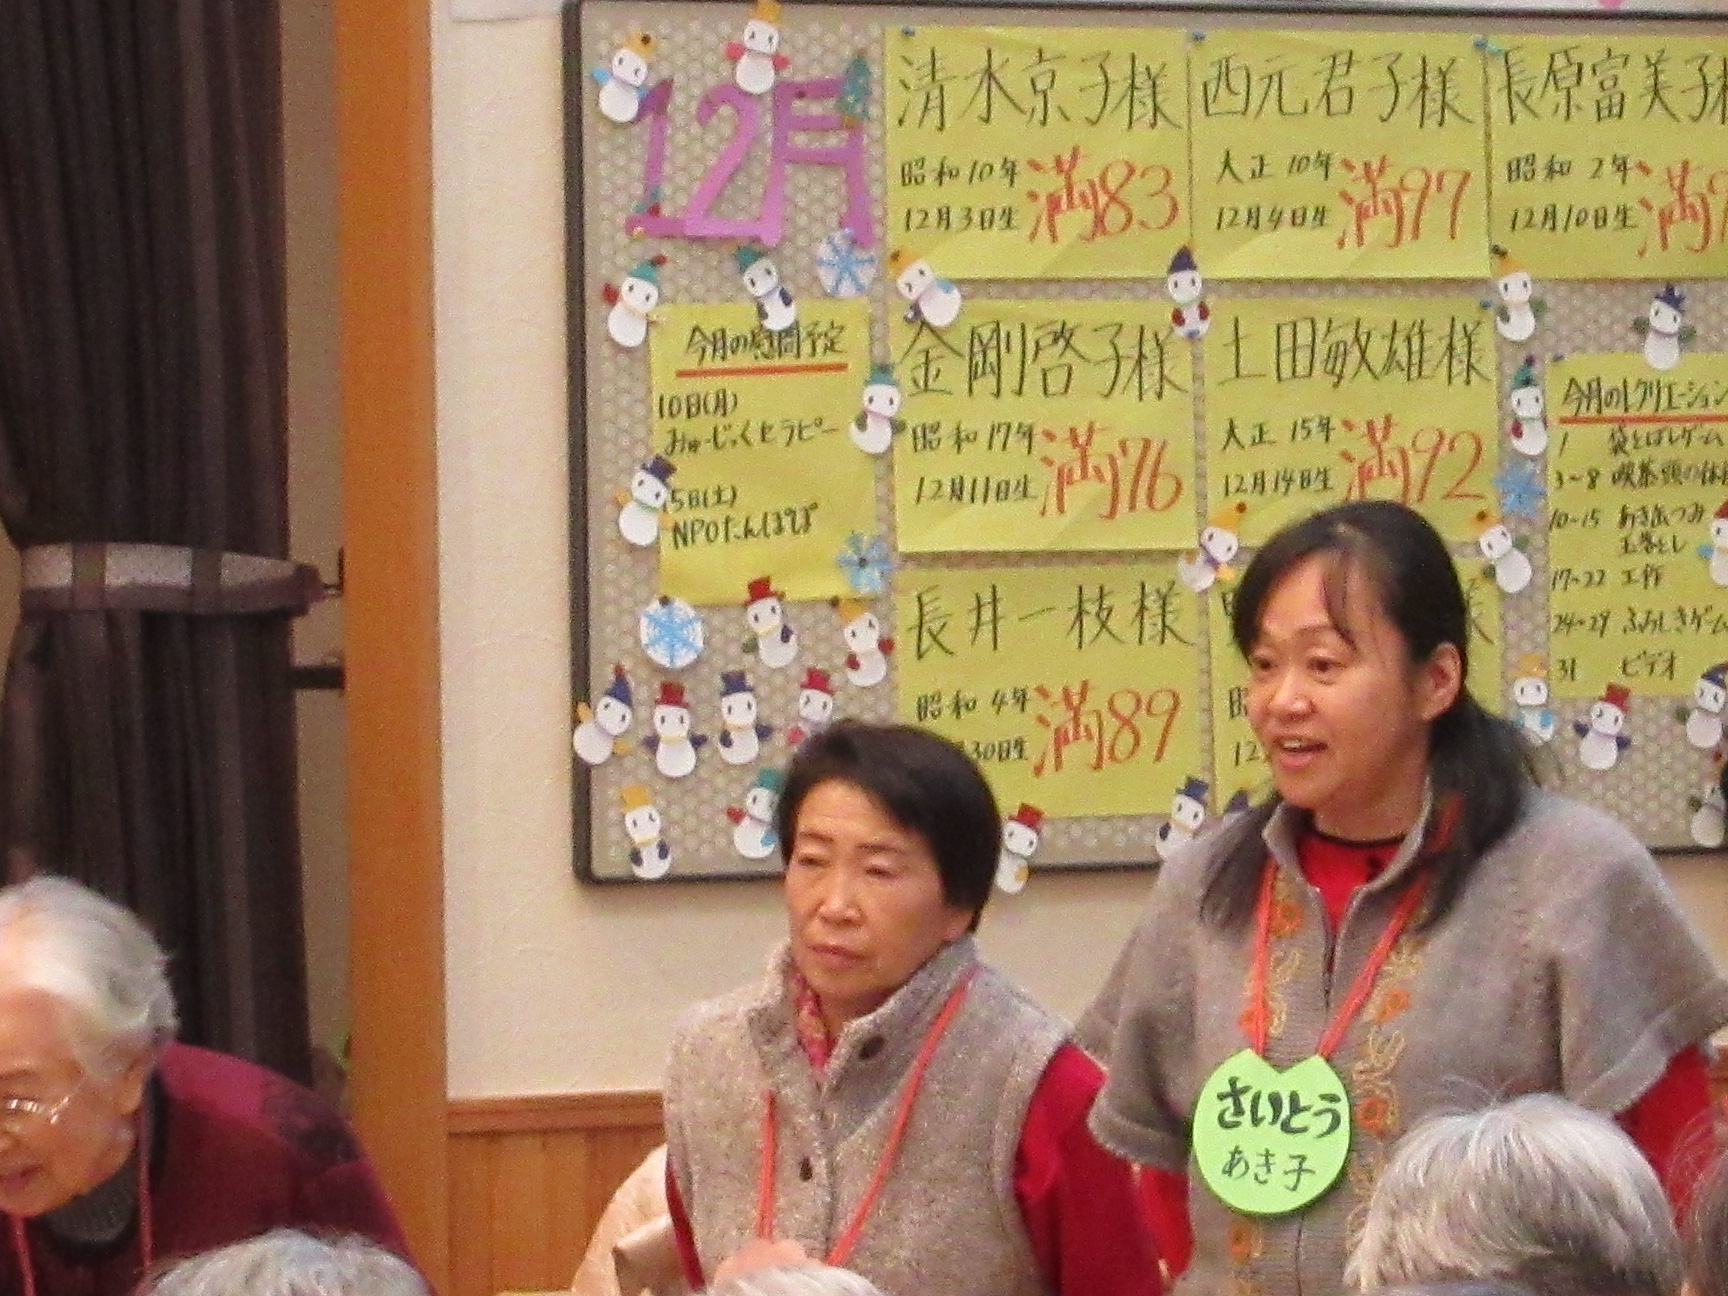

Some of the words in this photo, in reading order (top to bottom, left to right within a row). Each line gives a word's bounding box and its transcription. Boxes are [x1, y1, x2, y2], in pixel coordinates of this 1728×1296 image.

[900, 47, 1182, 131] 清水京子様
[1203, 49, 1473, 129] 西元君子様
[625, 76, 878, 245] 12月
[1027, 145, 1180, 243] 満83
[1338, 155, 1471, 248] 満97
[663, 485, 737, 512] 5日(土)
[1040, 421, 1184, 520] 満76
[908, 581, 1194, 661] 長井一枝様
[1034, 679, 1181, 778] 満89
[1217, 1075, 1341, 1138] さいとう
[1223, 1145, 1315, 1191] あき子
